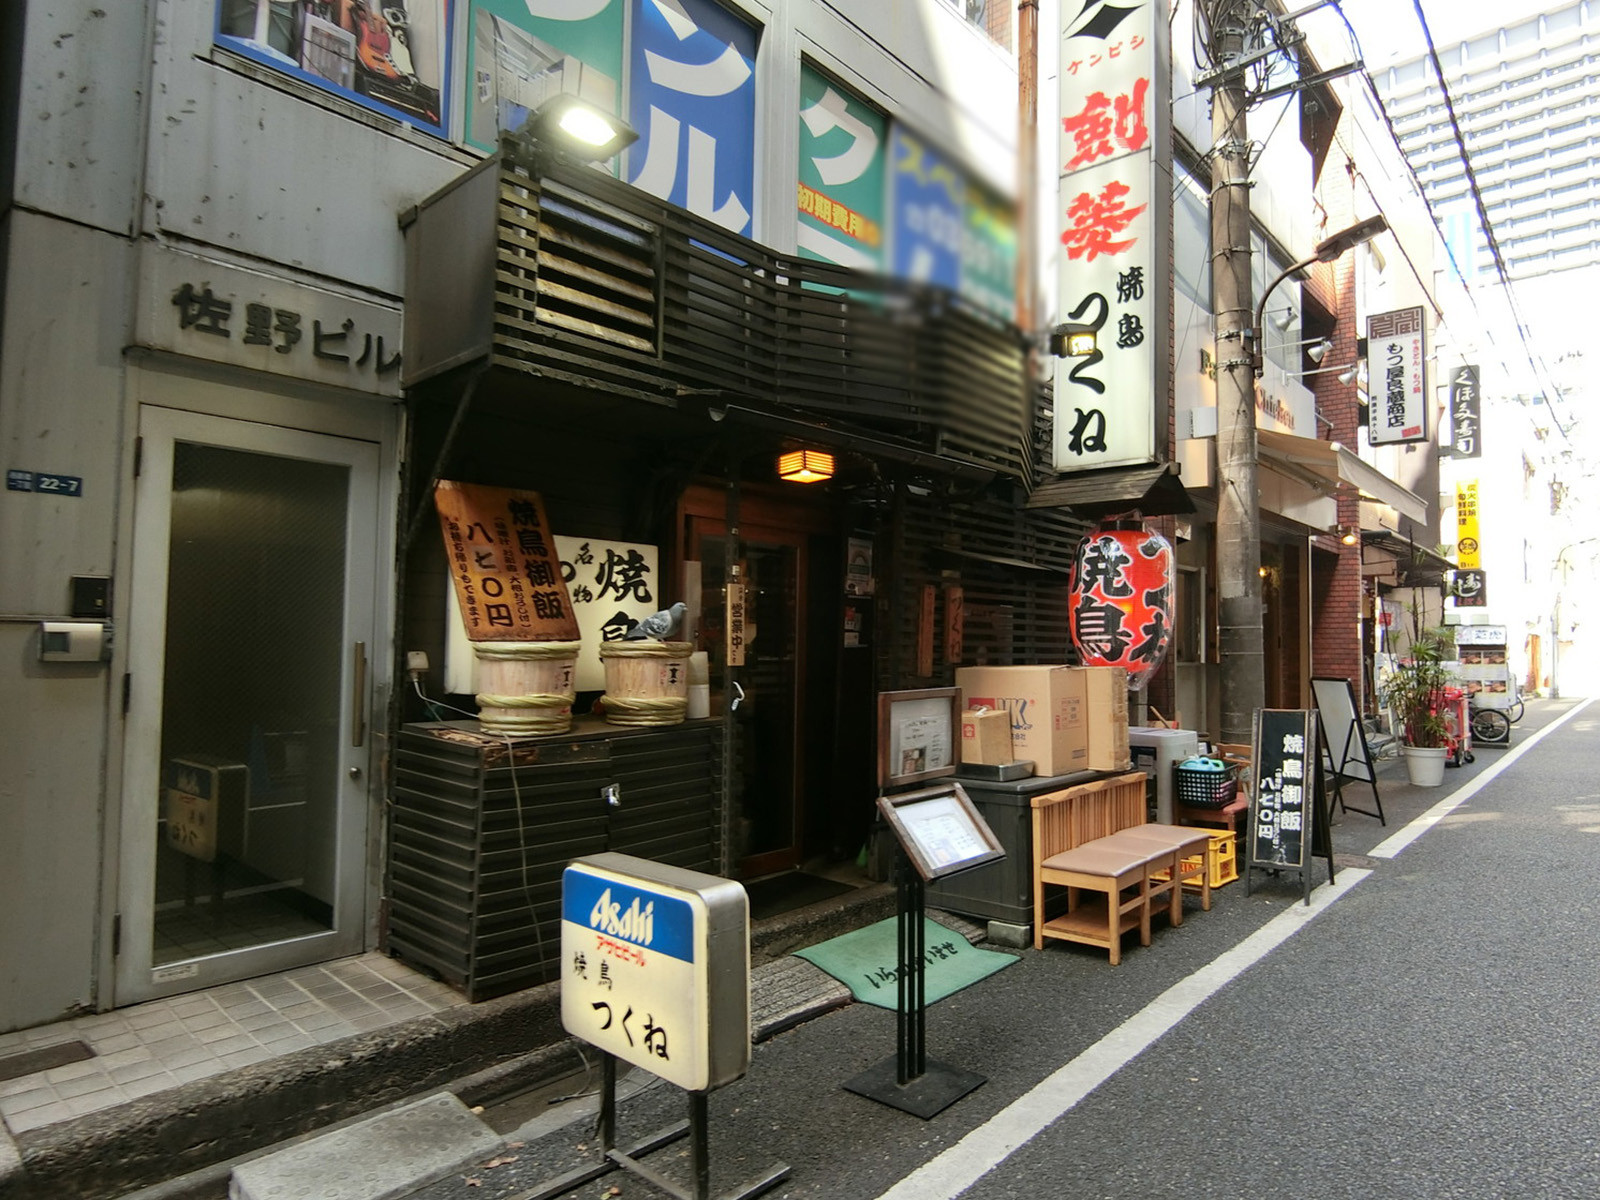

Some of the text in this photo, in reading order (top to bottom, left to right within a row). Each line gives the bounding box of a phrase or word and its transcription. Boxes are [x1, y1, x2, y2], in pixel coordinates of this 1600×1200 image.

[797, 180, 881, 248] 初期費用
[171, 283, 402, 374] 佐野ビル
[1116, 266, 1144, 349] 焼鳥
[1067, 292, 1109, 456] つくね
[40, 477, 79, 492] 22-7
[508, 499, 566, 620] 焼鳥御飯
[573, 542, 594, 604] 名物
[1070, 536, 1134, 662] 焼鳥
[1280, 733, 1304, 832] 焼鳥御飯
[590, 887, 654, 945] Asahi
[573, 950, 613, 992] 焼鳥
[592, 1000, 670, 1062] つくね
